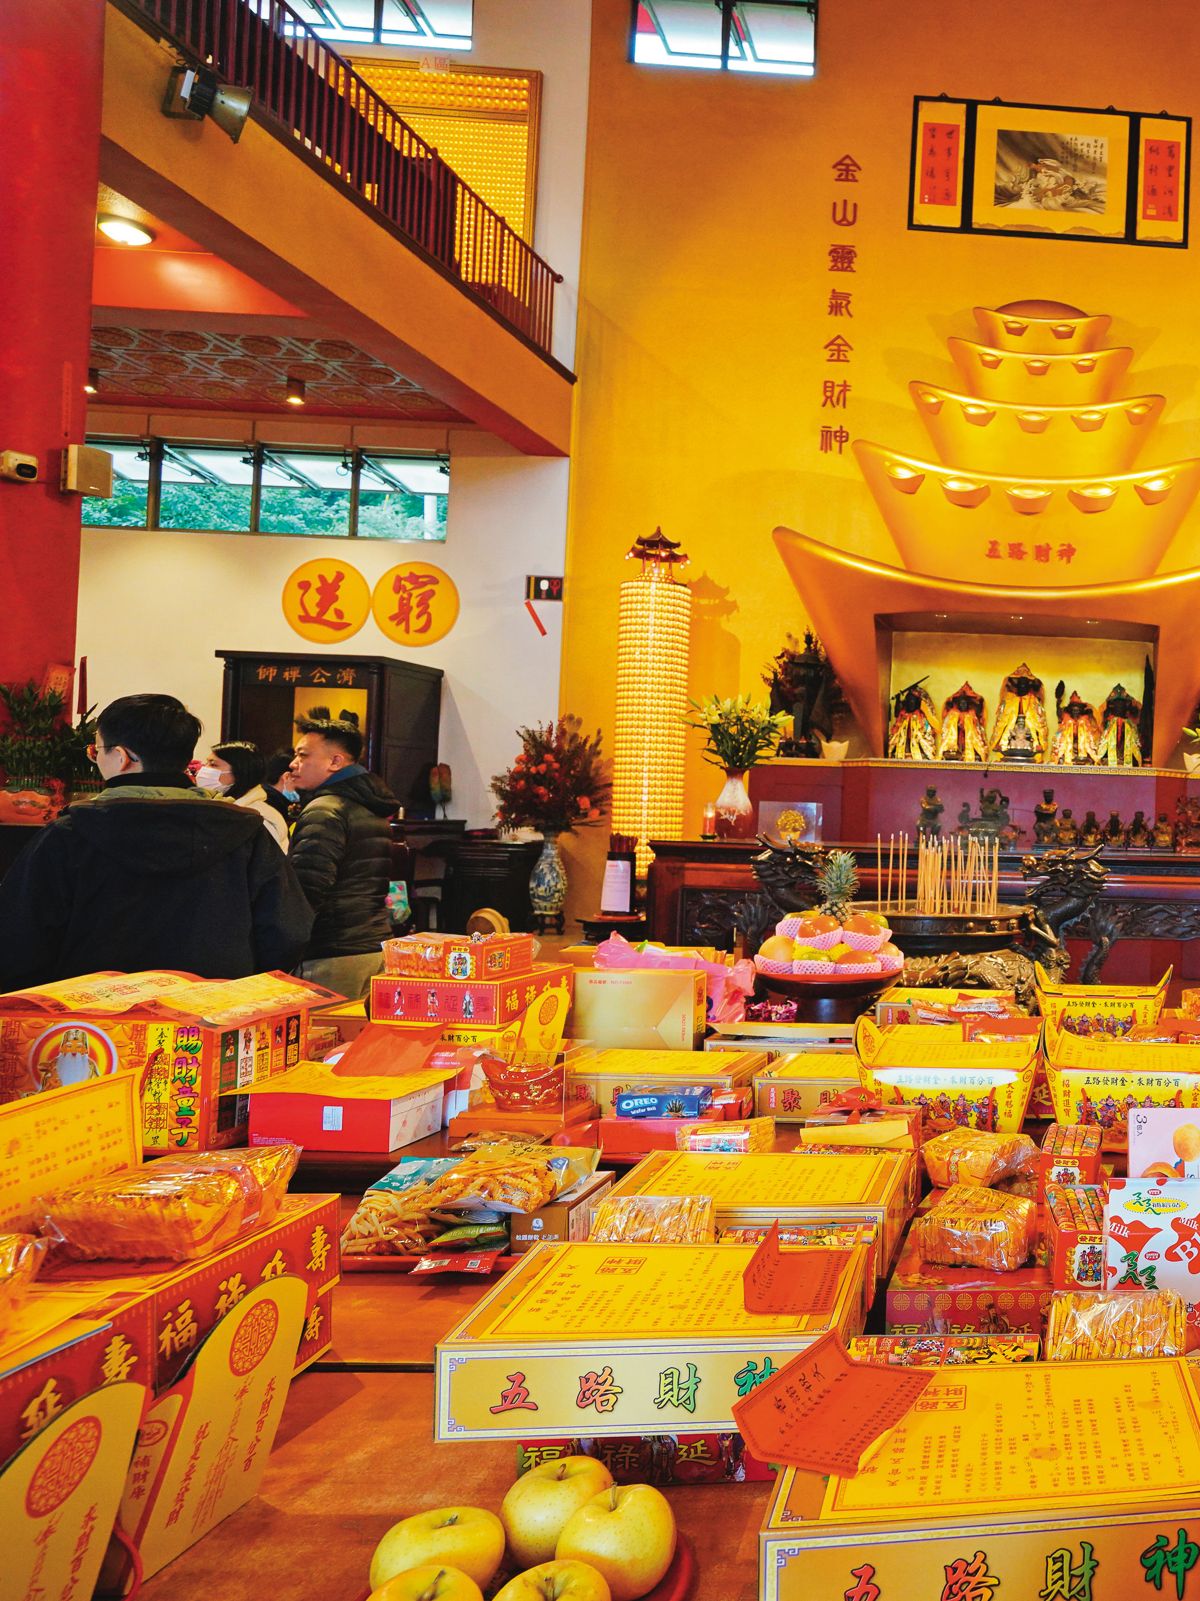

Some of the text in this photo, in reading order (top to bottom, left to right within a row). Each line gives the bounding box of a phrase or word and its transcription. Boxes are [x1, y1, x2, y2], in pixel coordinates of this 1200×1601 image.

[818, 153, 863, 455] 金山靈氣金財神
[985, 539, 1078, 564] 五路財神
[170, 1026, 203, 1147] 賜財童子
[620, 1097, 658, 1110] OREO
[490, 1356, 779, 1414] 五路財神
[843, 1527, 1200, 1600] 五路財神
